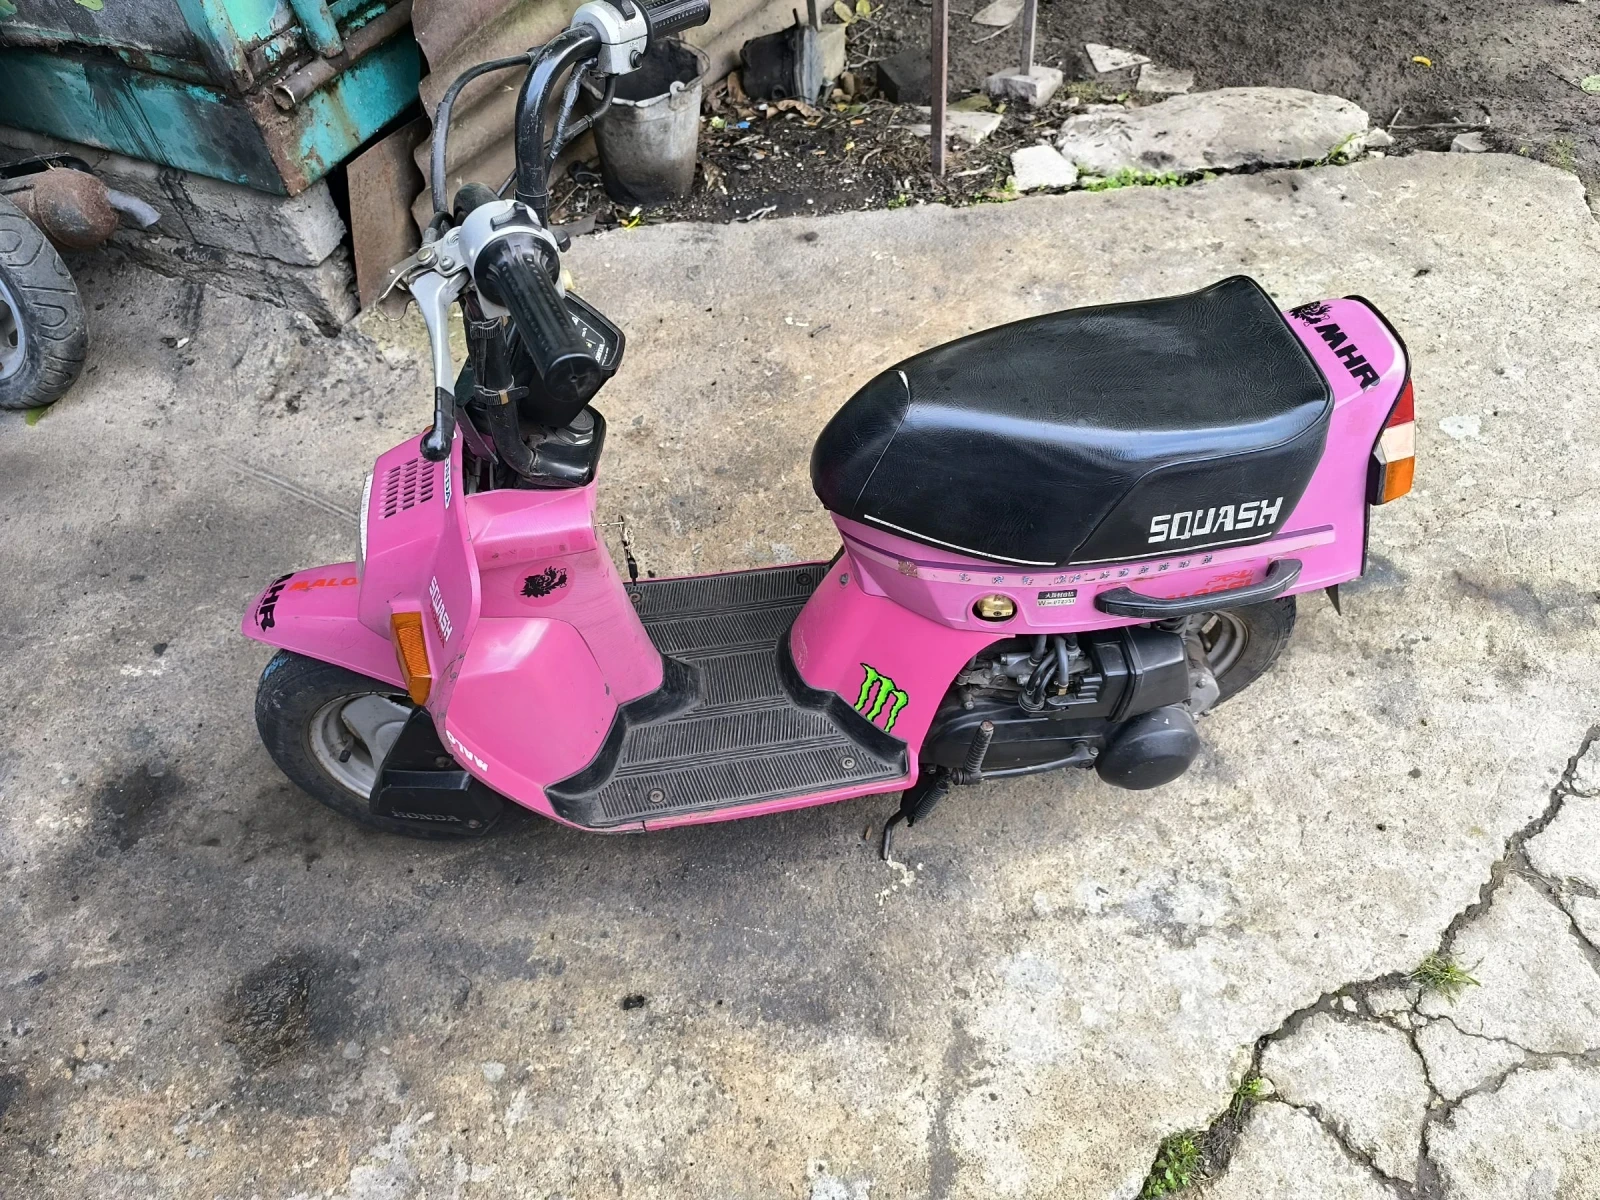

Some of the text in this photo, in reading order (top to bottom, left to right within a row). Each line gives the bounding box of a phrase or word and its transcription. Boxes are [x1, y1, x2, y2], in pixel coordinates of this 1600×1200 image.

[1314, 323, 1380, 389] MHR
[1148, 497, 1284, 544] SQUASH
[429, 575, 453, 642] SQUASH
[391, 808, 462, 822] HONDA
